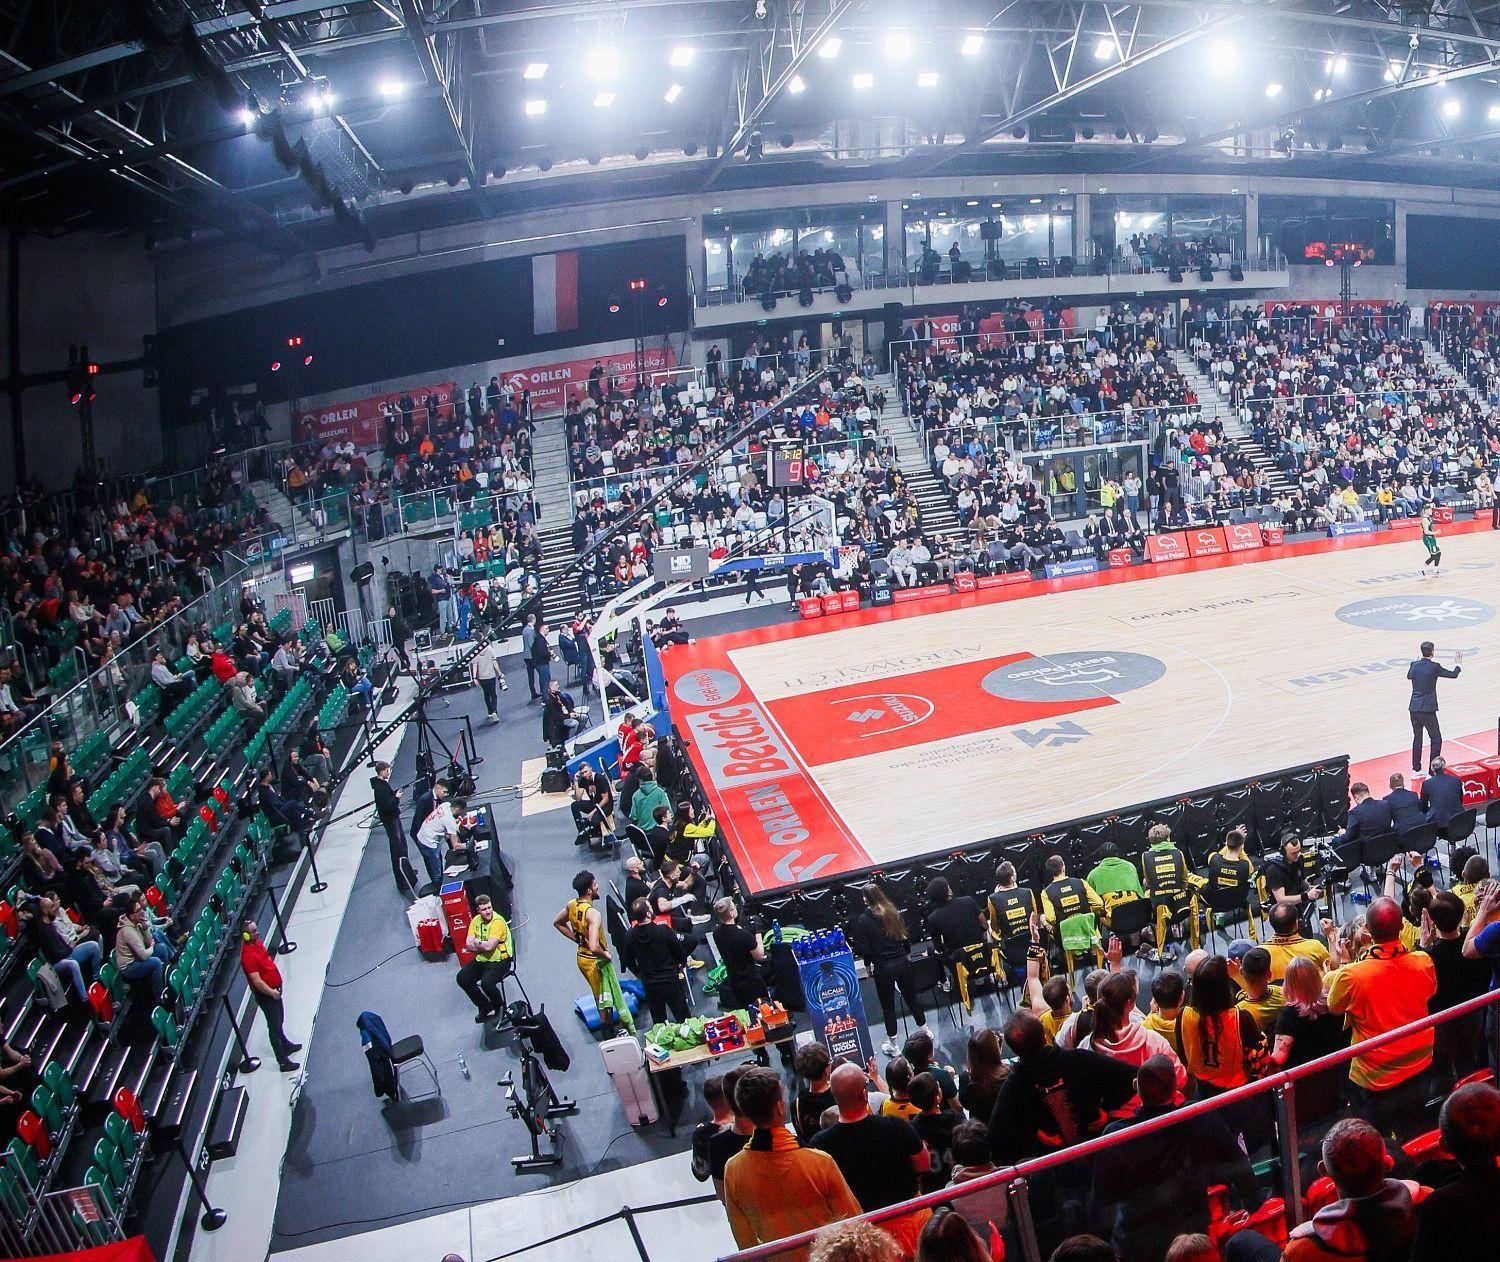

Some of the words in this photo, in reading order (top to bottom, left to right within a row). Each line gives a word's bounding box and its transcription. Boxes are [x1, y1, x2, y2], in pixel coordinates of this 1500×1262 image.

[531, 368, 572, 384] ORLEN
[530, 387, 560, 398] SUZUKI
[320, 408, 358, 425] ORLEN
[789, 462, 801, 482] 9
[1245, 541, 1259, 549] Pekao
[1155, 553, 1168, 561] Bank
[1169, 551, 1185, 560] Pekao
[1287, 658, 1417, 688] ORLEN
[697, 708, 791, 778] Betclic
[744, 784, 811, 846] ORLEN
[833, 1043, 857, 1054] WODA
